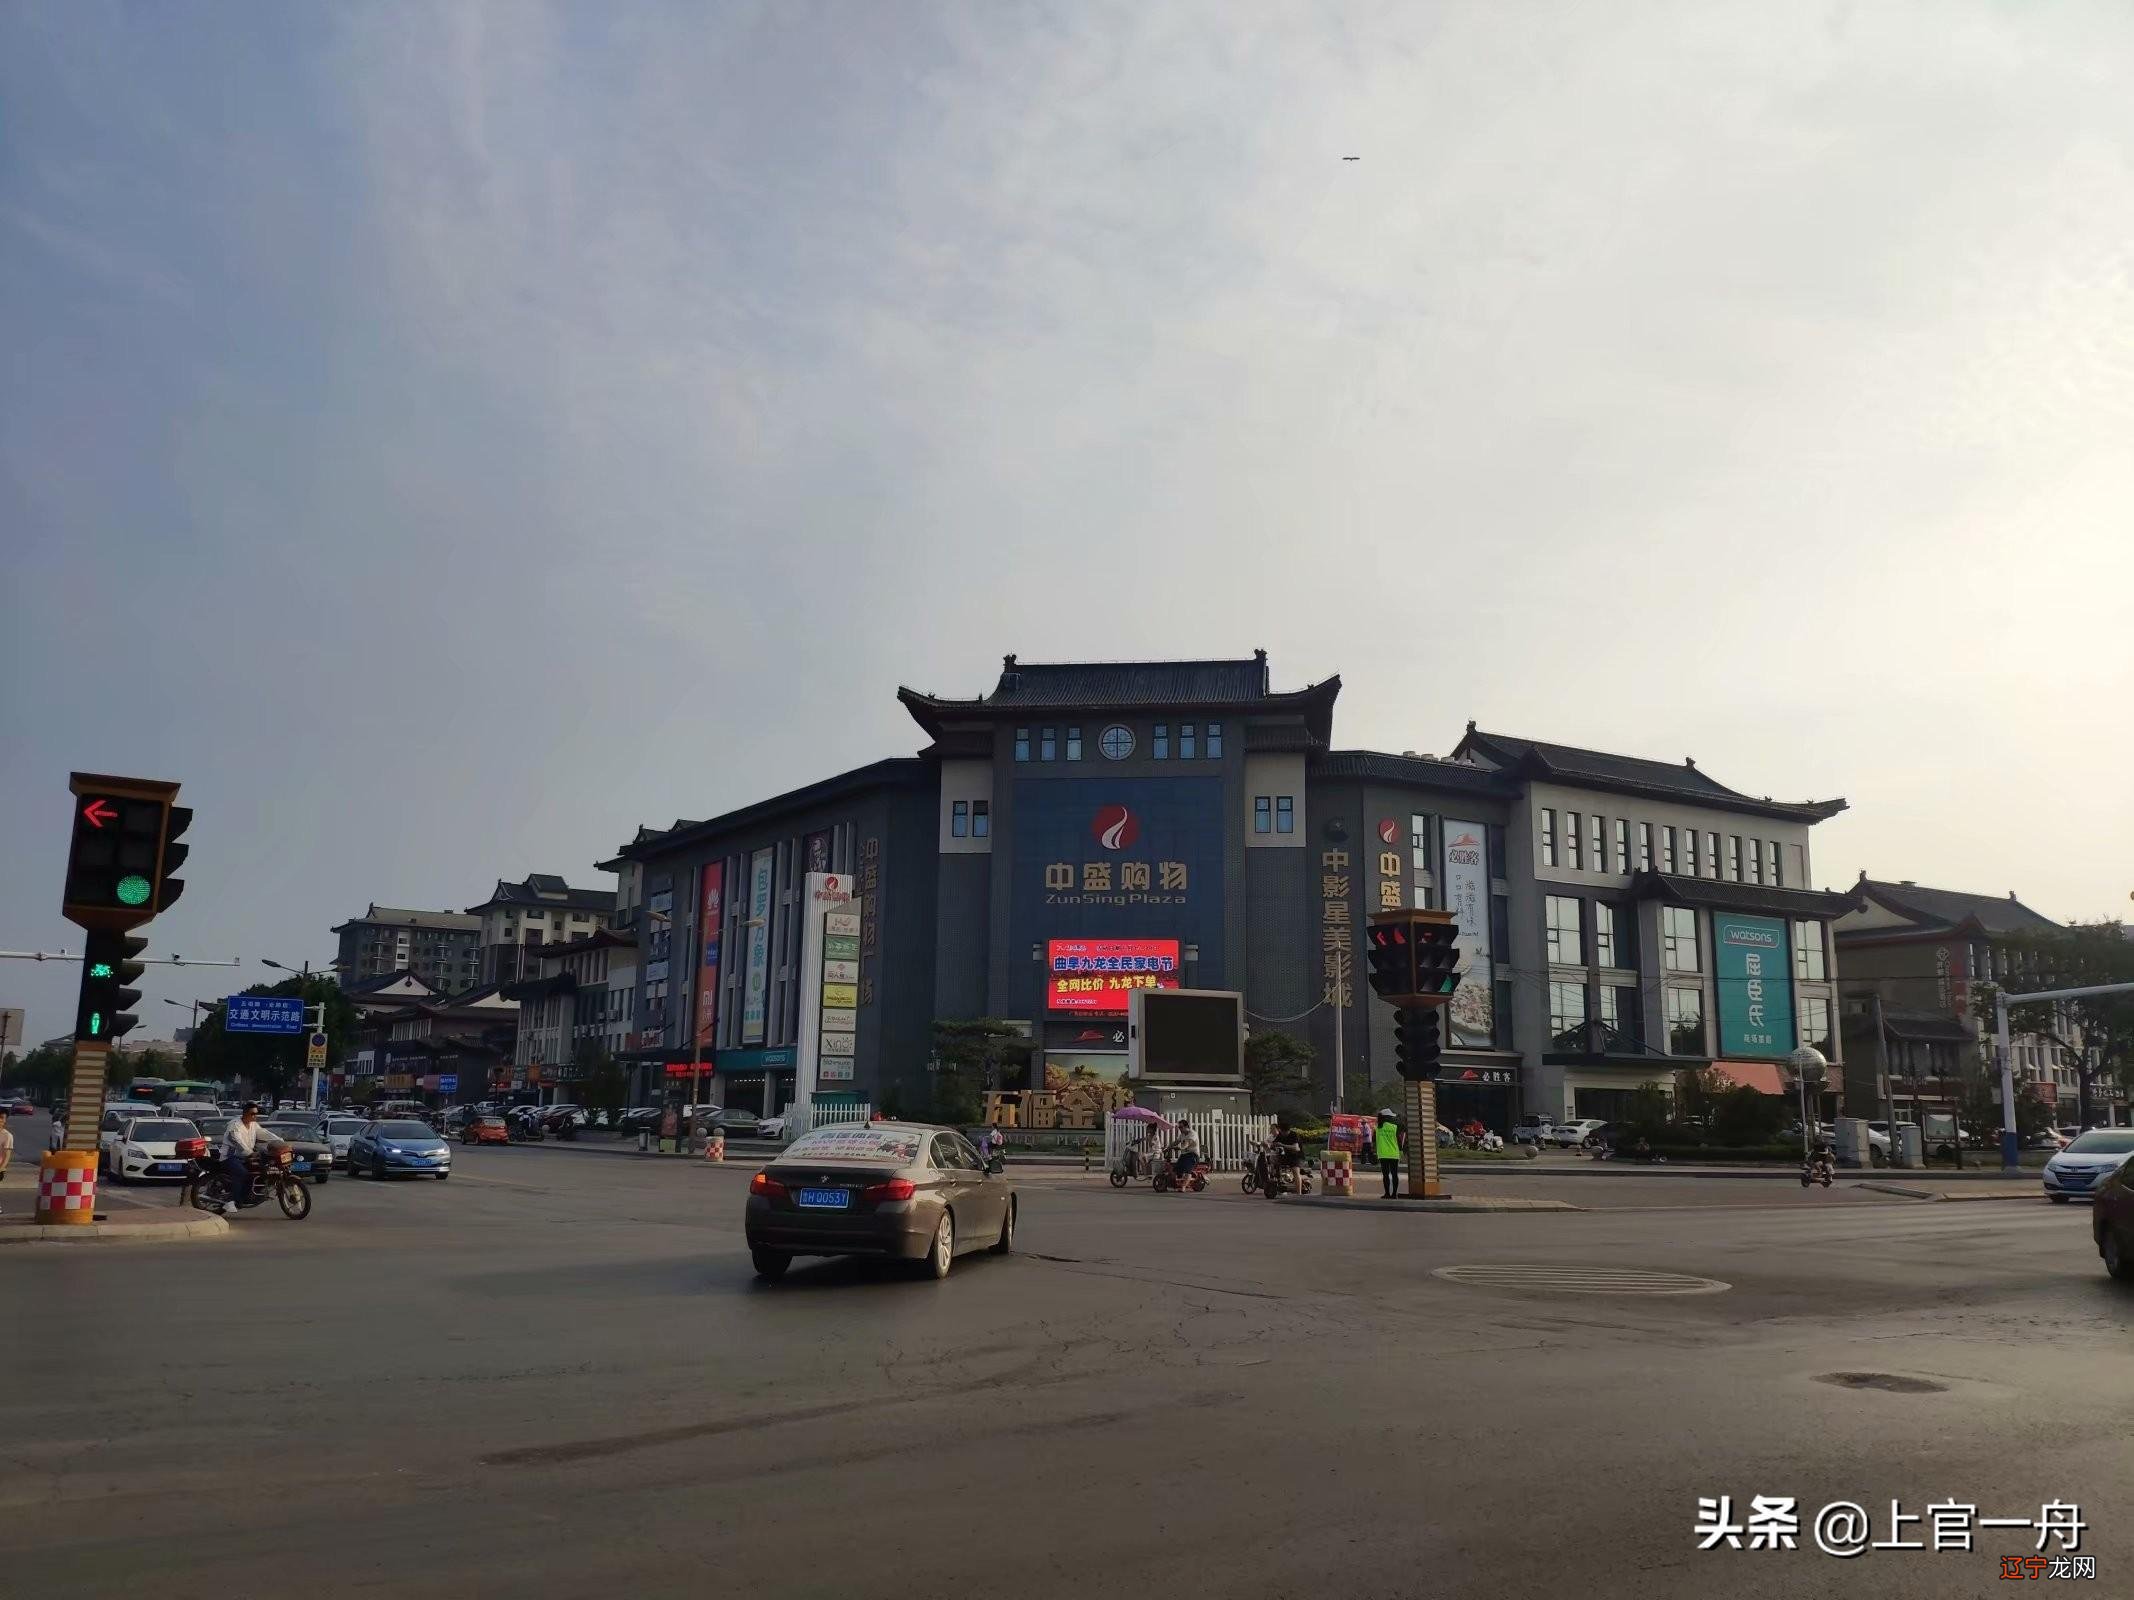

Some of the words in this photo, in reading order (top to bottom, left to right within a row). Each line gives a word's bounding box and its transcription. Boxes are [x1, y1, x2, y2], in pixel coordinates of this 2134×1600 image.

[1045, 862, 1189, 891] 中盛购物
[1379, 851, 1402, 912] 中盛
[1130, 894, 1187, 905] Plaza
[1321, 848, 1353, 1008] 中影星美影城
[1731, 930, 1773, 943] watsons
[1054, 956, 1174, 971] 曲阜九龙全民家电节
[1056, 977, 1105, 993] 全网比价
[1109, 975, 1158, 990] 九龙下单
[229, 1008, 301, 1022] 交通文明示范路
[1482, 1071, 1512, 1083] 必胜客
